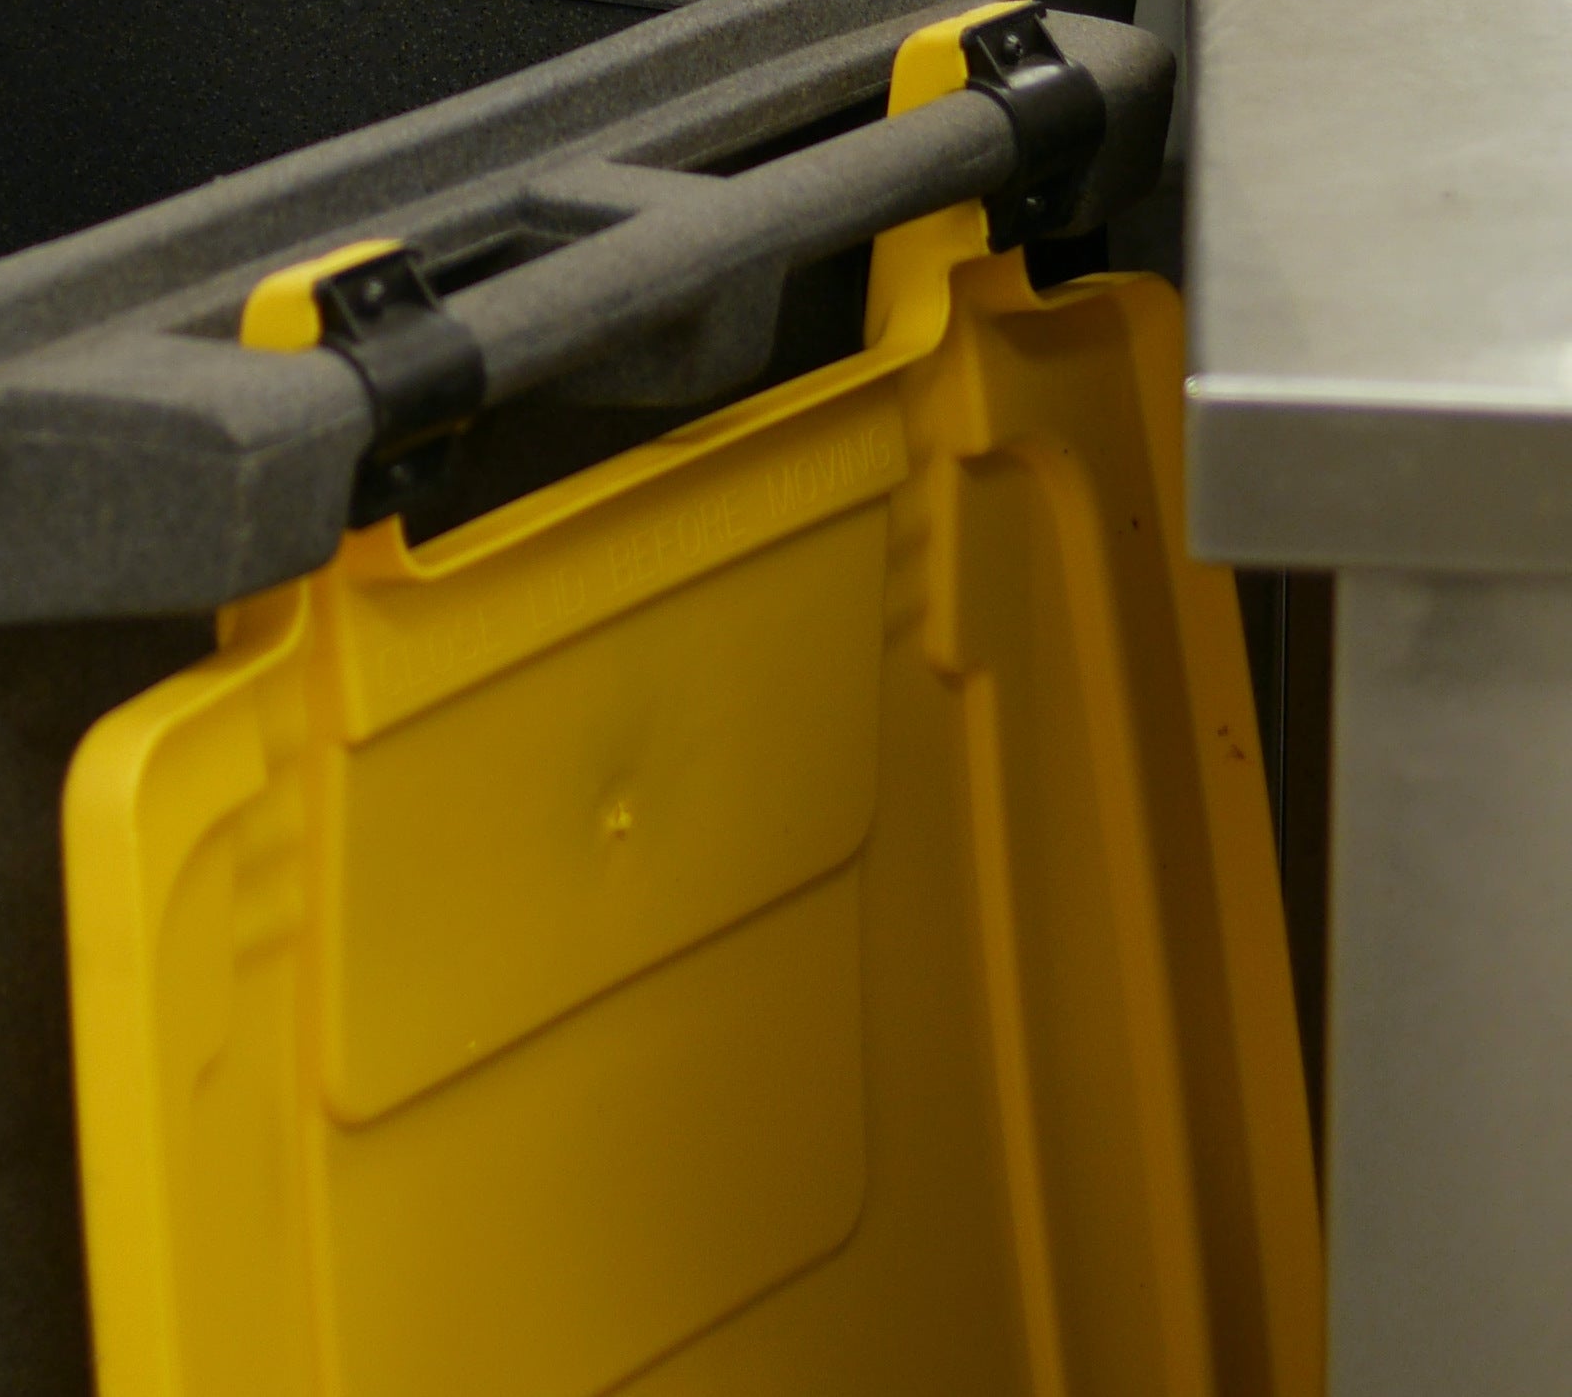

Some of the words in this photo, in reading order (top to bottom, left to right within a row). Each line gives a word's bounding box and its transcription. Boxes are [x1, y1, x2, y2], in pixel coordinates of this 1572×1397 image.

[527, 565, 586, 630] LID
[606, 490, 746, 593] BEFORE
[765, 427, 891, 520] MOVING
